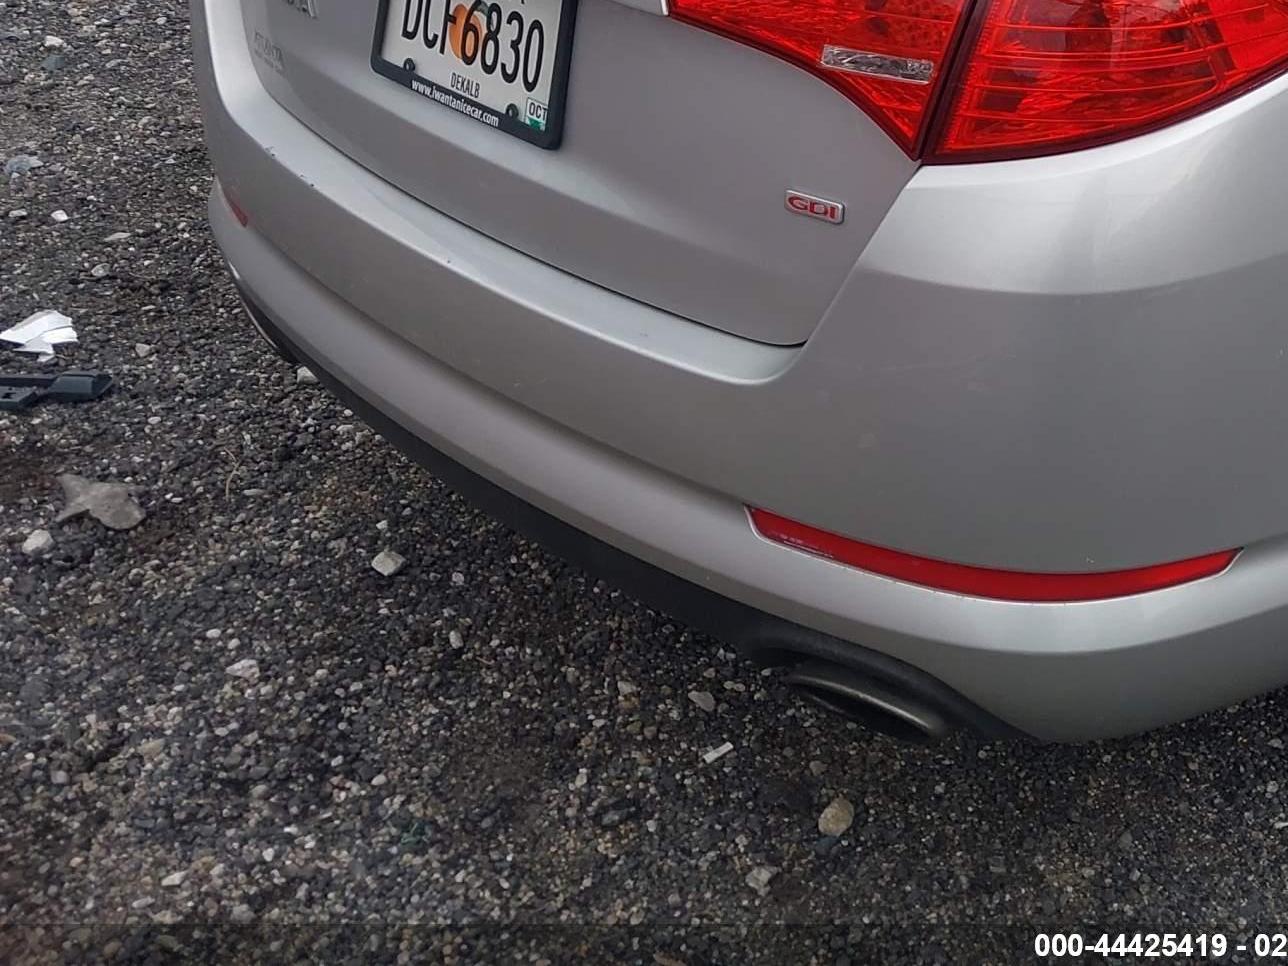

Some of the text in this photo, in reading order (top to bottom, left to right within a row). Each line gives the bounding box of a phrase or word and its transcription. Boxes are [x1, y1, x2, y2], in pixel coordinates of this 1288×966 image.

[450, 71, 481, 99] DEKALB
[411, 78, 499, 127] www.iwantanicecar.com
[528, 101, 548, 121] OCT
[787, 195, 837, 221] GDI
